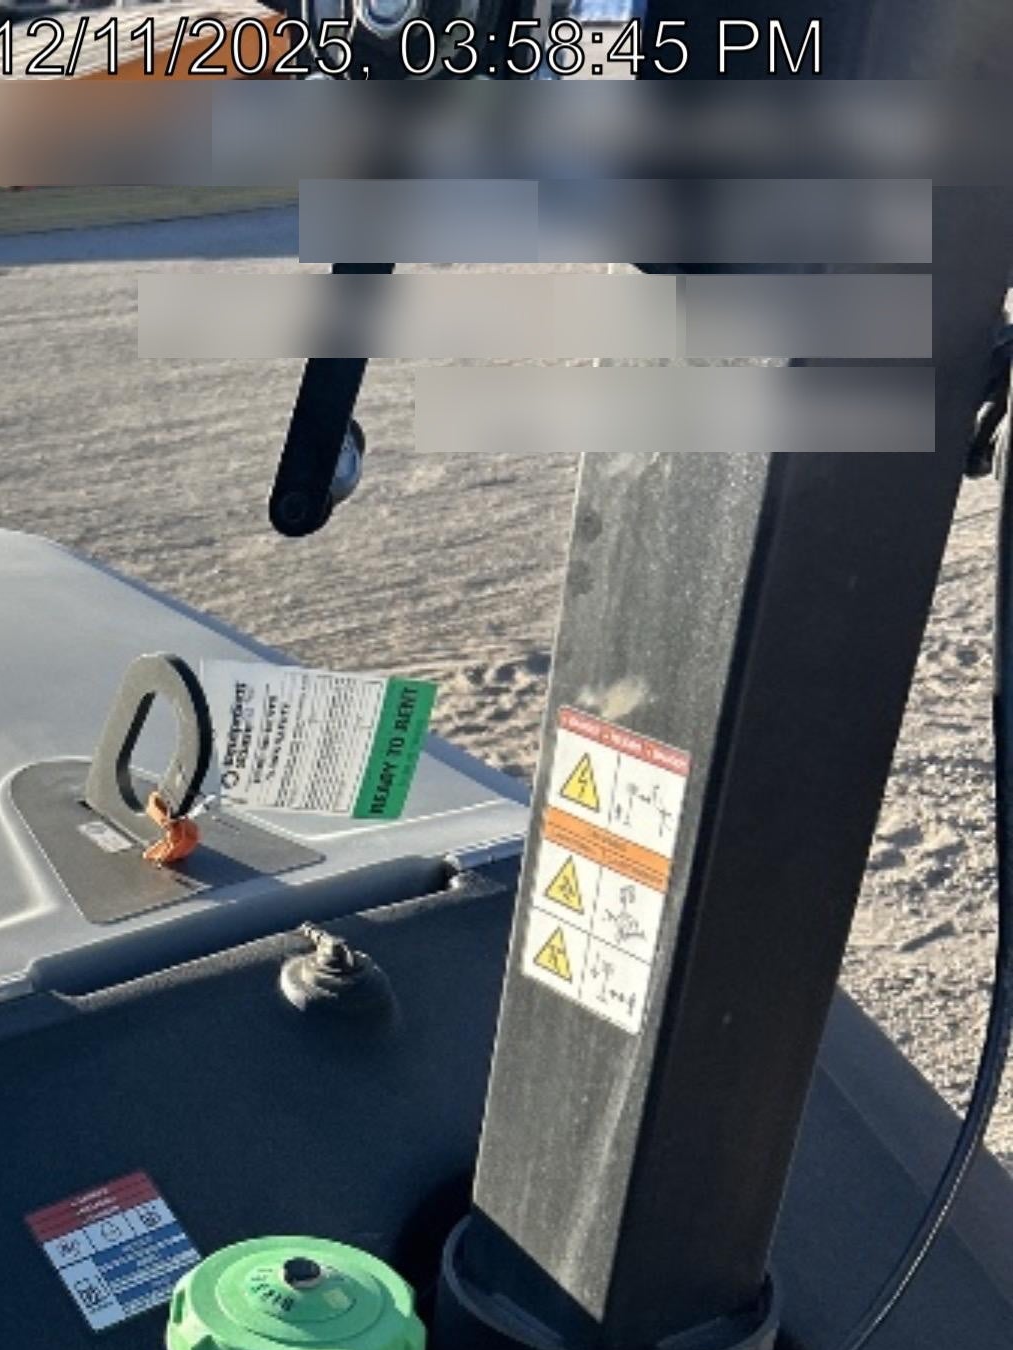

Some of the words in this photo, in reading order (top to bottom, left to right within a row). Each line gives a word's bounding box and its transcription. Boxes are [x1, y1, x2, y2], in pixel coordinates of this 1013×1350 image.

[394, 687, 418, 730] RENT
[391, 736, 404, 757] TO
[370, 762, 398, 814] READY
